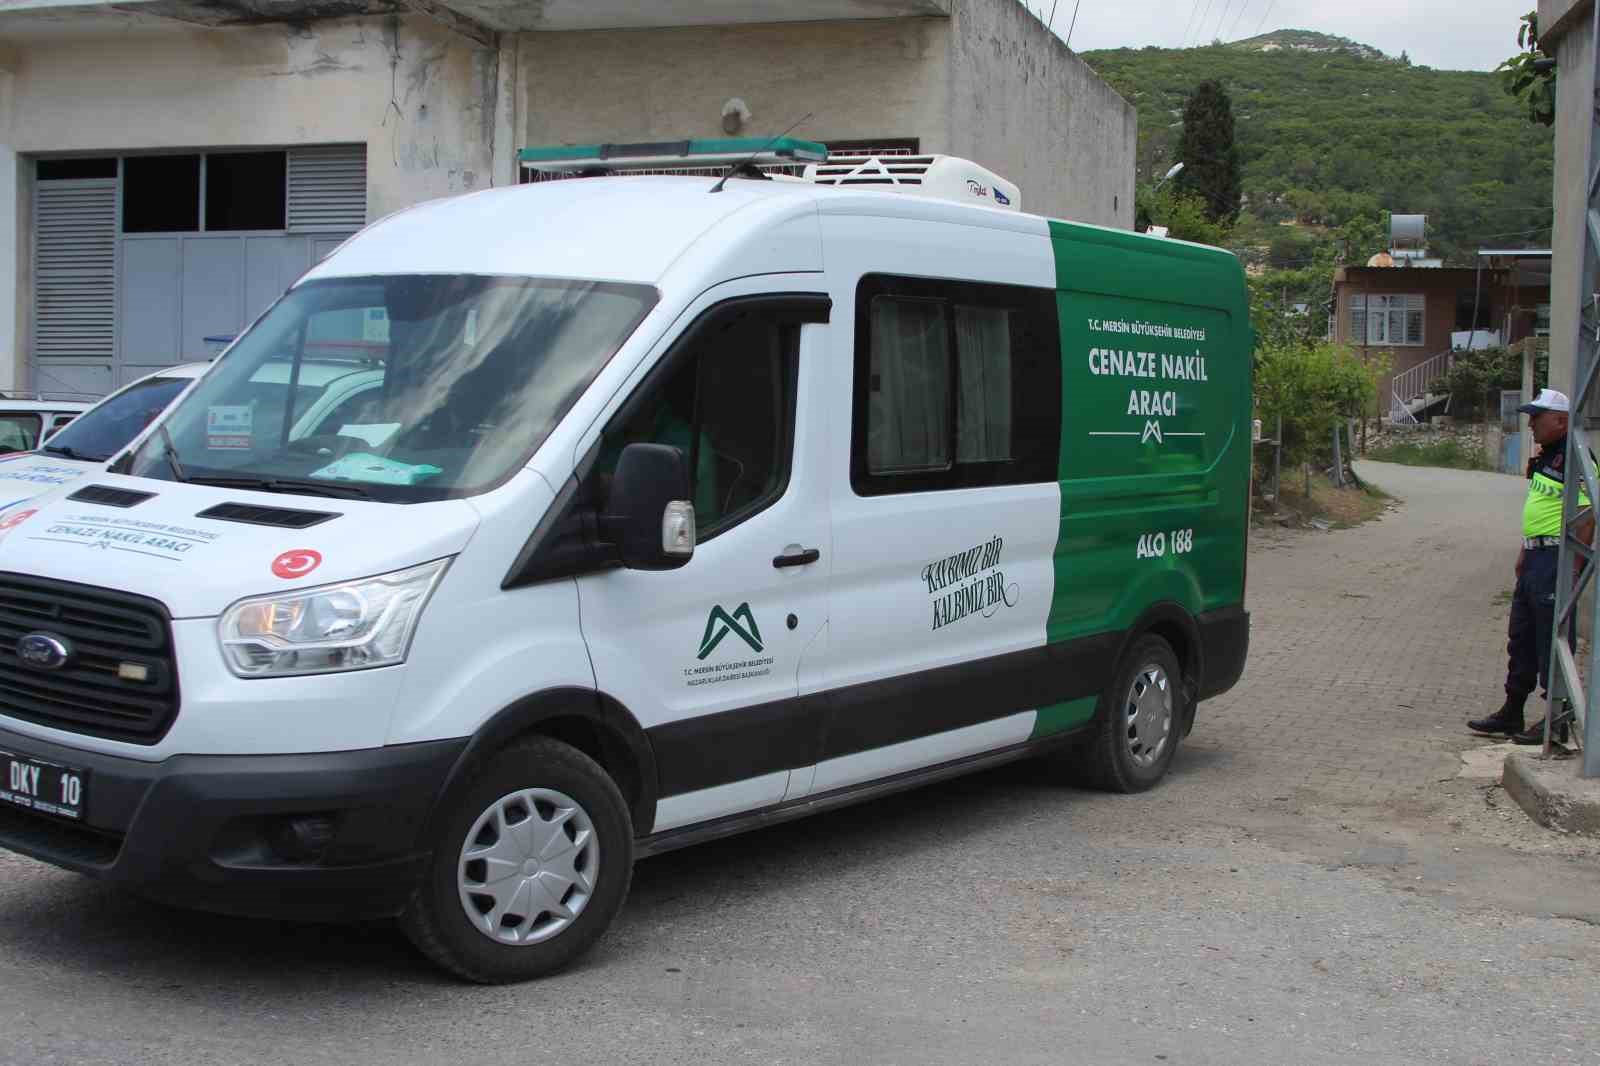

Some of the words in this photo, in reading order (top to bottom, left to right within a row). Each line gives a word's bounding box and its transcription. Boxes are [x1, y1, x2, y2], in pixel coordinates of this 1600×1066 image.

[1103, 318, 1130, 334] MERSİN
[1174, 326, 1206, 341] BELEDİYESİ
[1088, 347, 1156, 378] CENAZE
[1161, 349, 1208, 381] NAKİL
[1127, 389, 1176, 416] ARACI
[1136, 532, 1165, 559] ALO
[1171, 528, 1193, 554] 188
[921, 545, 983, 594] KAYBIMIZ
[981, 535, 1003, 571] BİR
[932, 578, 985, 630] KALBİMİZ
[985, 569, 1020, 608] BİR
[10, 760, 40, 796] DKY
[61, 773, 80, 806] 10
